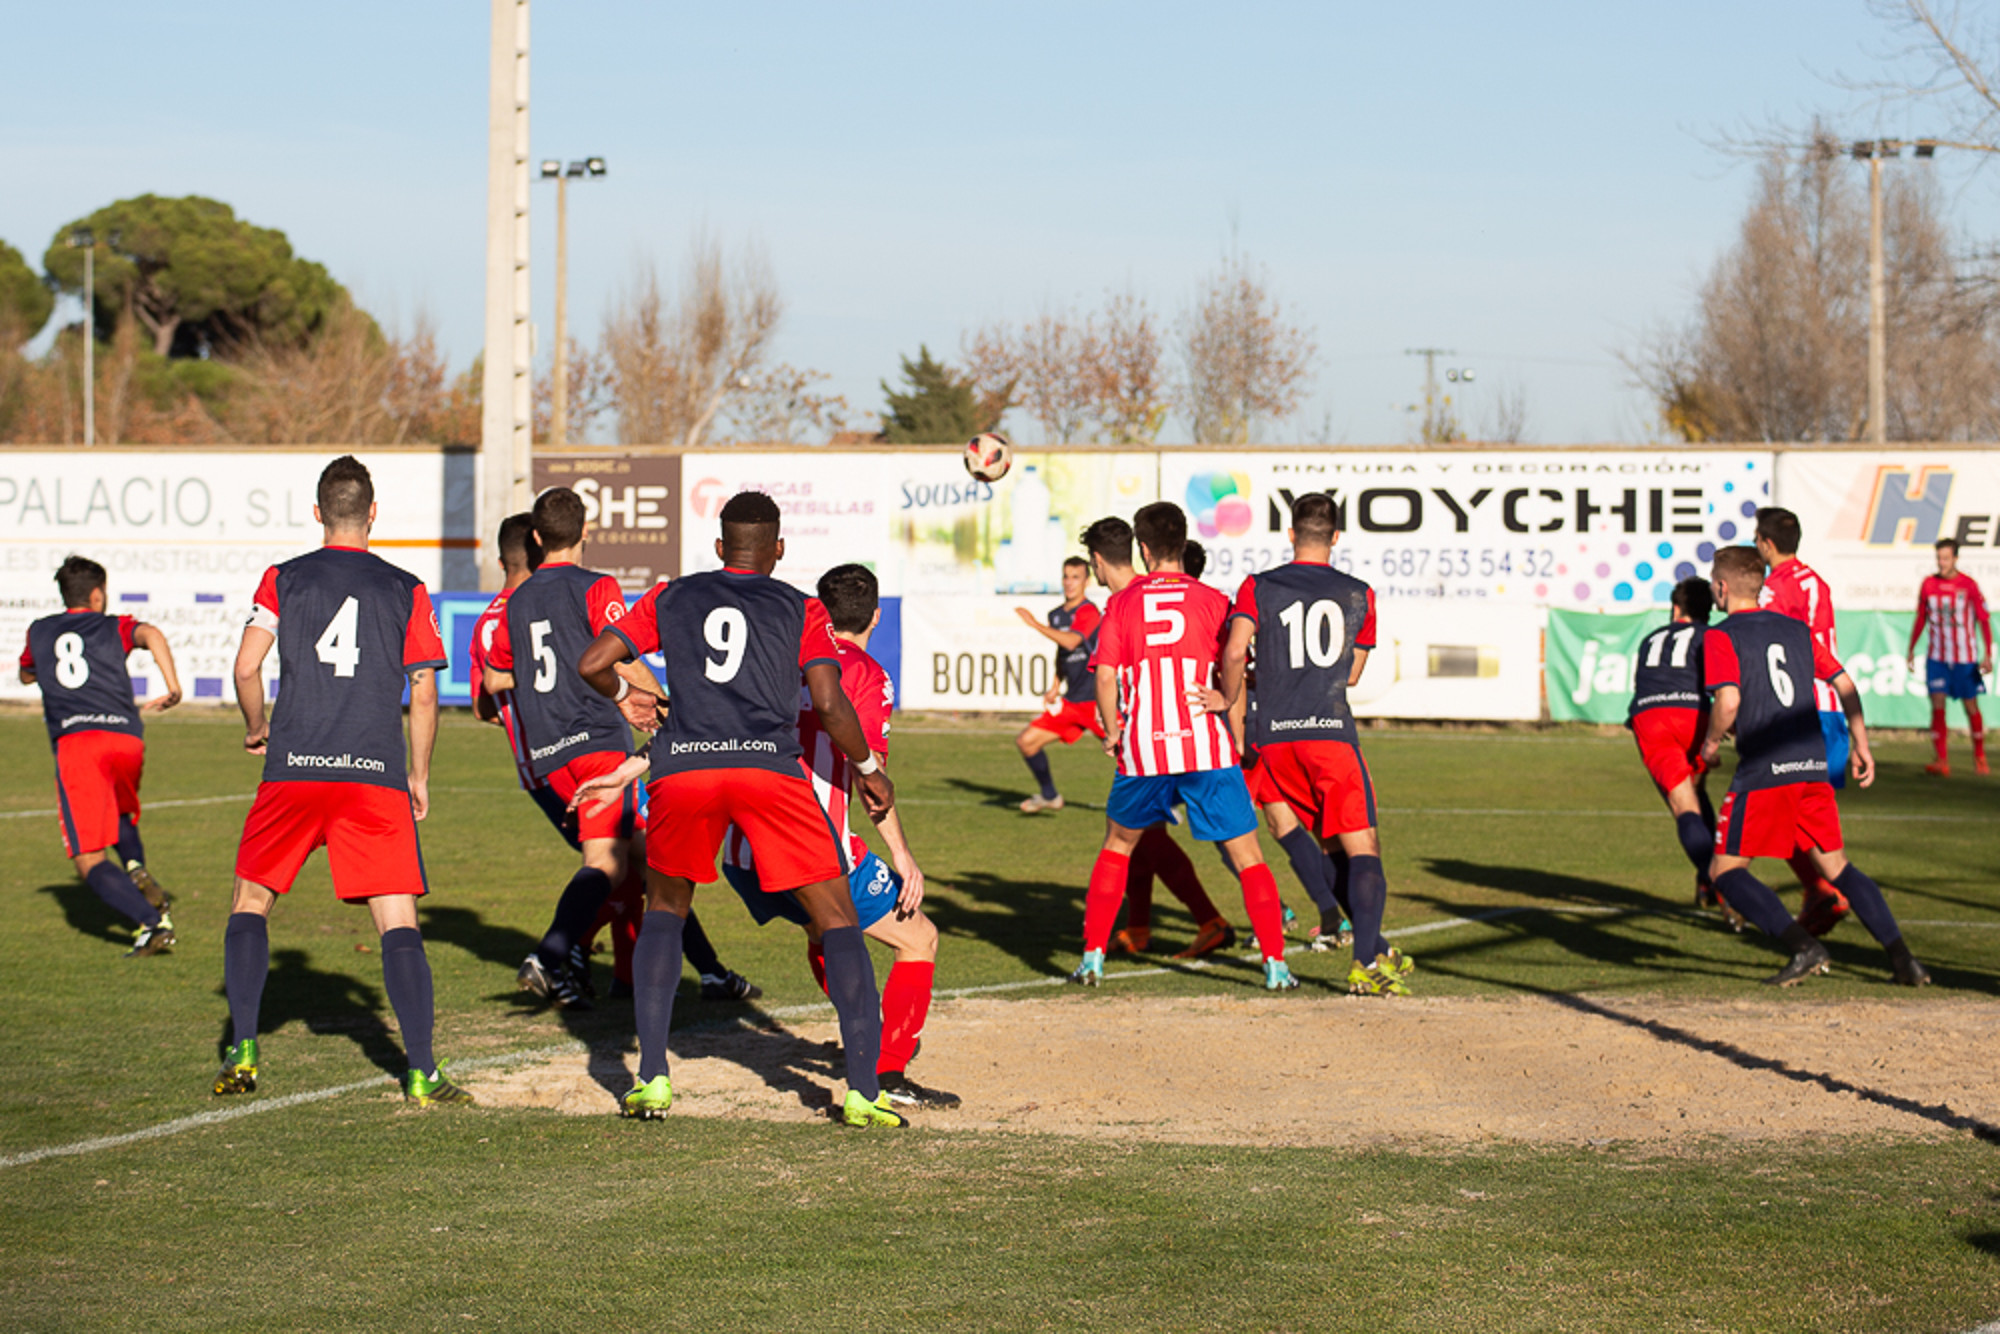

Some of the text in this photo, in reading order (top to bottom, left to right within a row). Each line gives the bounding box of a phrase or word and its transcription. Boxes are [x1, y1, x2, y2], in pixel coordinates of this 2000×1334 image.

[1272, 457, 1701, 474] PINTURA Y DECORACIÓN
[779, 501, 874, 514] DESILLAS
[597, 531, 668, 544] COCINAS
[1205, 548, 1233, 575] 09
[1382, 549, 1430, 577] 687
[1438, 549, 1470, 577] 53
[1480, 549, 1511, 577] 54
[1522, 549, 1553, 577] 32
[315, 595, 361, 678] 4
[1143, 592, 1186, 647] 5
[1279, 599, 1346, 669] 10
[54, 631, 90, 689] 8
[529, 619, 558, 693] 5
[703, 606, 749, 684] 9
[1645, 627, 1696, 668] 11
[1766, 643, 1795, 708] 6
[1269, 714, 1345, 732] berrocall.com
[287, 751, 386, 772] berrocall.com
[670, 739, 778, 755] berrocall.com
